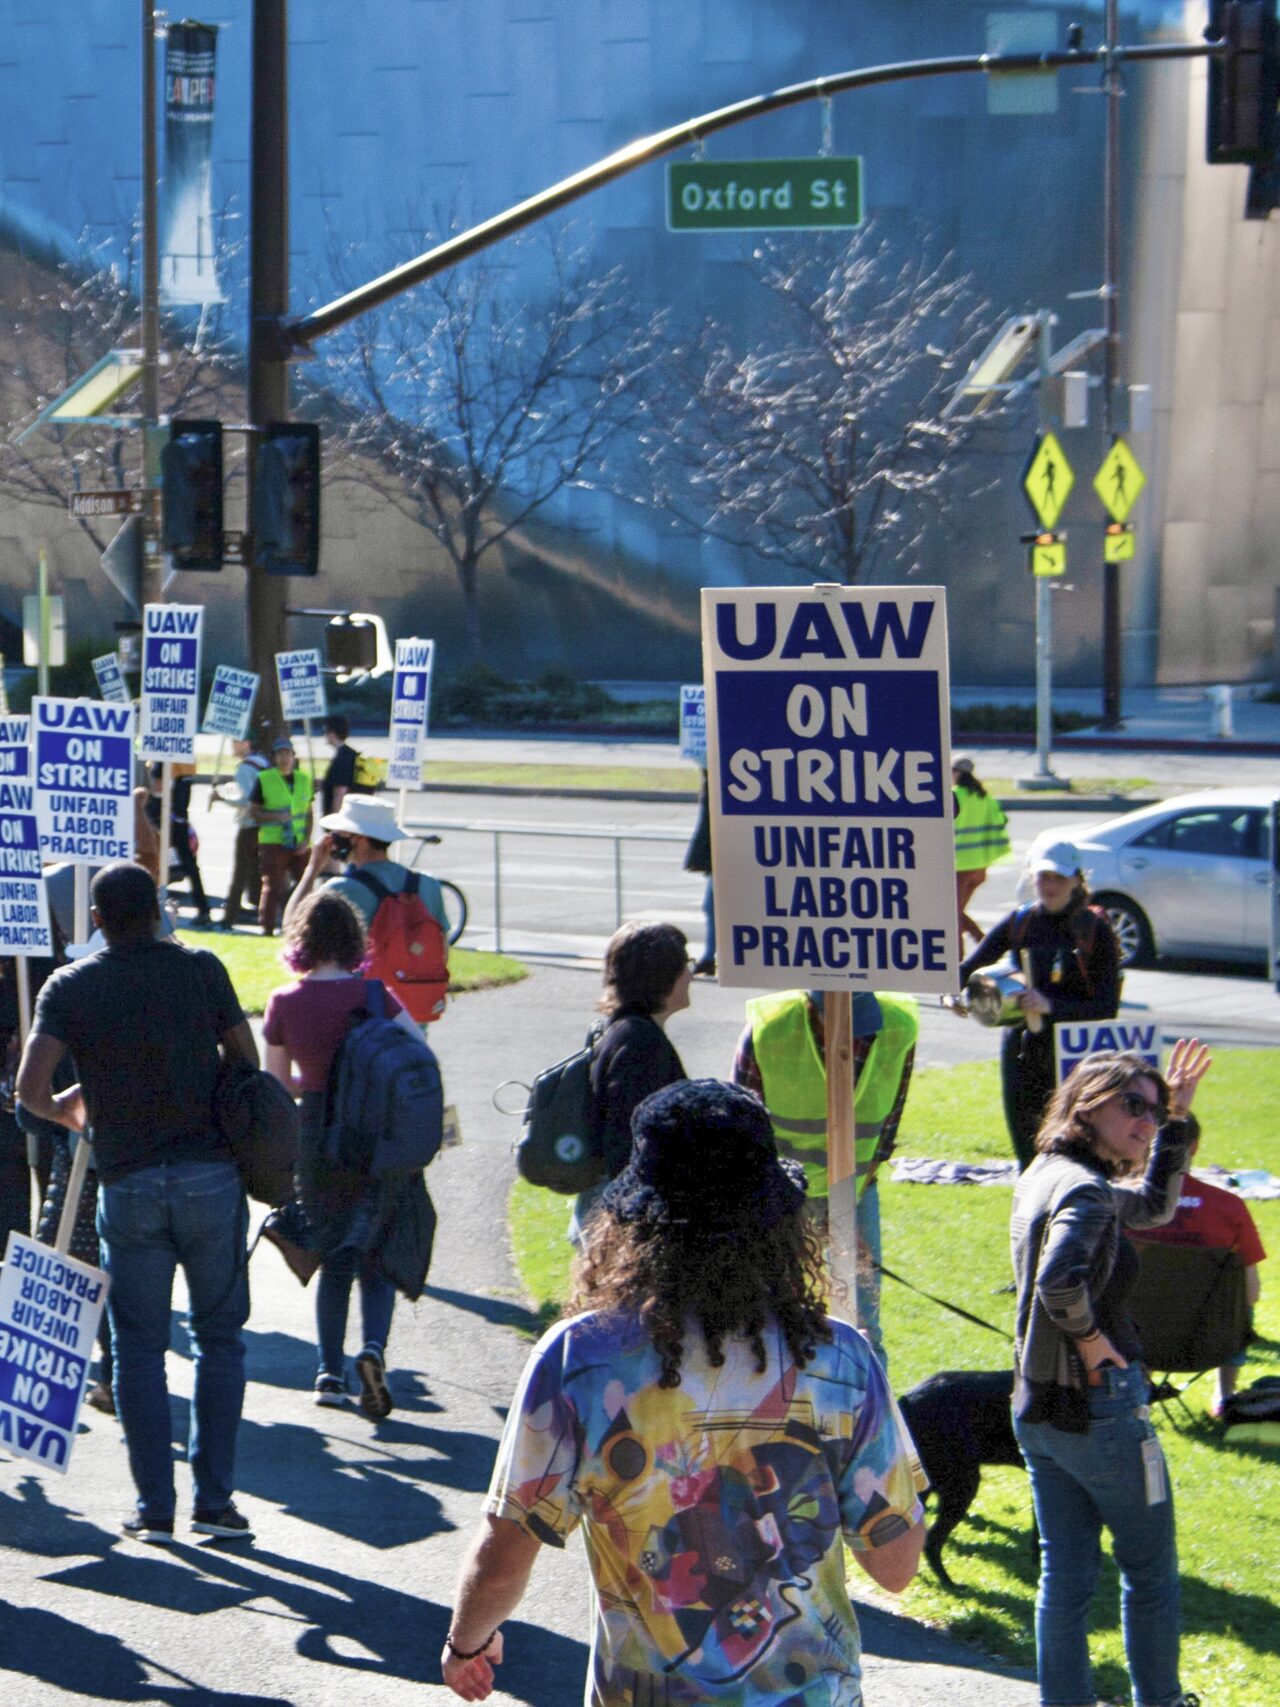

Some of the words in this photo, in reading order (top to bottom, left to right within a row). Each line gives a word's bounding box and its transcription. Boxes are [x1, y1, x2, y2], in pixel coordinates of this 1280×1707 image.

[682, 181, 792, 211] Oxford
[810, 179, 847, 209] St
[73, 495, 114, 515] Addison
[147, 611, 198, 634] UAW
[716, 601, 936, 660] UAW
[160, 642, 182, 664] ON
[278, 653, 315, 665] UAW
[398, 647, 430, 667] UAW
[145, 667, 195, 690] STRIKE
[217, 669, 255, 686] UAW
[281, 677, 319, 691] STRIKE
[291, 667, 306, 678] ON
[211, 693, 249, 712] STRIKE
[225, 685, 240, 697] ON
[684, 689, 704, 699] UA
[150, 698, 188, 714] UNFAIR
[394, 700, 424, 721] STRIKE
[786, 683, 868, 738] ON
[39, 704, 130, 732] UAW
[151, 716, 185, 734] LABOR
[66, 738, 102, 762] ON
[143, 735, 193, 754] PRACTICE
[39, 762, 128, 791] STRIKE
[727, 747, 936, 804] STRIKE
[50, 795, 117, 816] UNFAIR
[0, 819, 24, 843] ON
[53, 816, 114, 836] LABOR
[40, 835, 129, 858] PRACTICE
[754, 826, 916, 869] UNFAIR
[764, 876, 909, 920] LABOR
[2, 904, 39, 924] LABOR
[732, 925, 947, 971] PRACTICE
[1061, 1025, 1155, 1053] UAW
[10, 1245, 102, 1304] PRACTICE
[21, 1277, 82, 1322] LABOR
[12, 1300, 79, 1348] UNFAIR
[12, 1374, 49, 1411] ON
